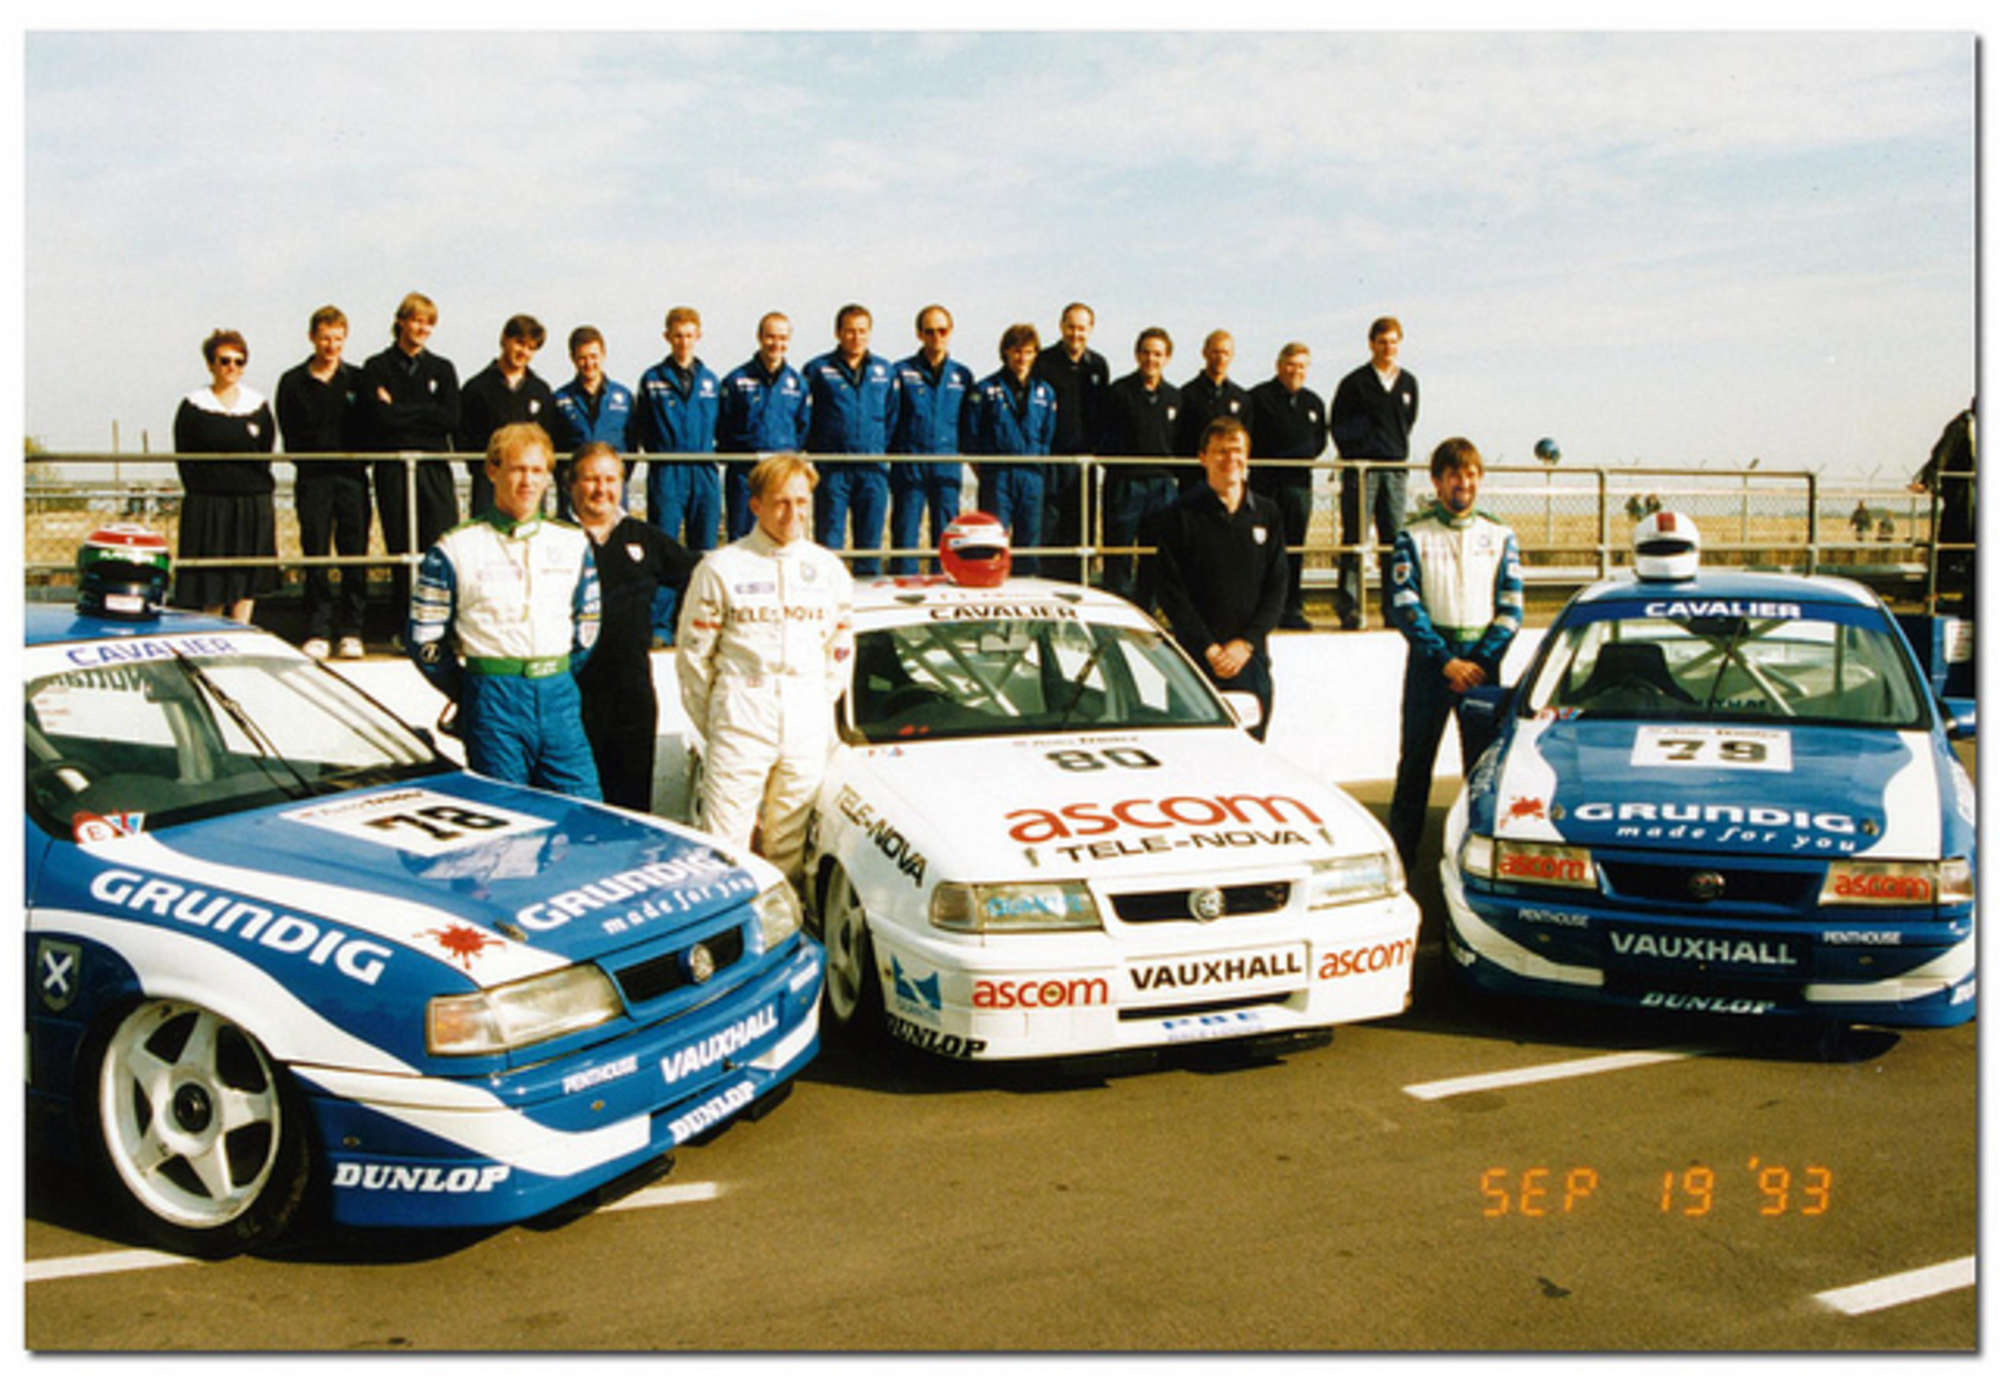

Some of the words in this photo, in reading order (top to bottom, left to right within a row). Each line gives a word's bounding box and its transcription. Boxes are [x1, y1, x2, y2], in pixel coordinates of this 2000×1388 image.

[929, 606, 1079, 620] CAVALIER
[1645, 602, 1801, 619] CAVALIER
[66, 637, 239, 666] CAVALIER
[1046, 748, 1161, 772] 80
[1657, 738, 1768, 763] 79
[364, 806, 510, 841] 78
[1004, 795, 1323, 843] ascom
[1574, 803, 1856, 834] GRUNDIG
[836, 784, 927, 888] TELE-NOVA
[1056, 830, 1311, 862] TELE-NOVA
[1617, 825, 1705, 840] made
[1717, 826, 1778, 843] for
[1792, 833, 1856, 851] you
[1500, 854, 1587, 882] ascom
[517, 846, 731, 930] GRUNDIG
[1833, 874, 1931, 899] ascom
[602, 899, 673, 935] made
[673, 887, 712, 912] for
[1518, 907, 1589, 928] PENTHOUSE
[90, 870, 392, 986] GRUNDIG
[1822, 931, 1902, 944] PENTHOUSE
[1318, 938, 1414, 980] ascom
[1609, 931, 1797, 965] VAUXHALL
[1130, 952, 1302, 990] VAUXHALL
[972, 978, 1108, 1009] ascom
[1640, 991, 1776, 1015] DUNLOP
[660, 1005, 779, 1083] VAUXHALL
[667, 1080, 756, 1144] DUNLOP
[332, 1163, 511, 1192] DUNLOP
